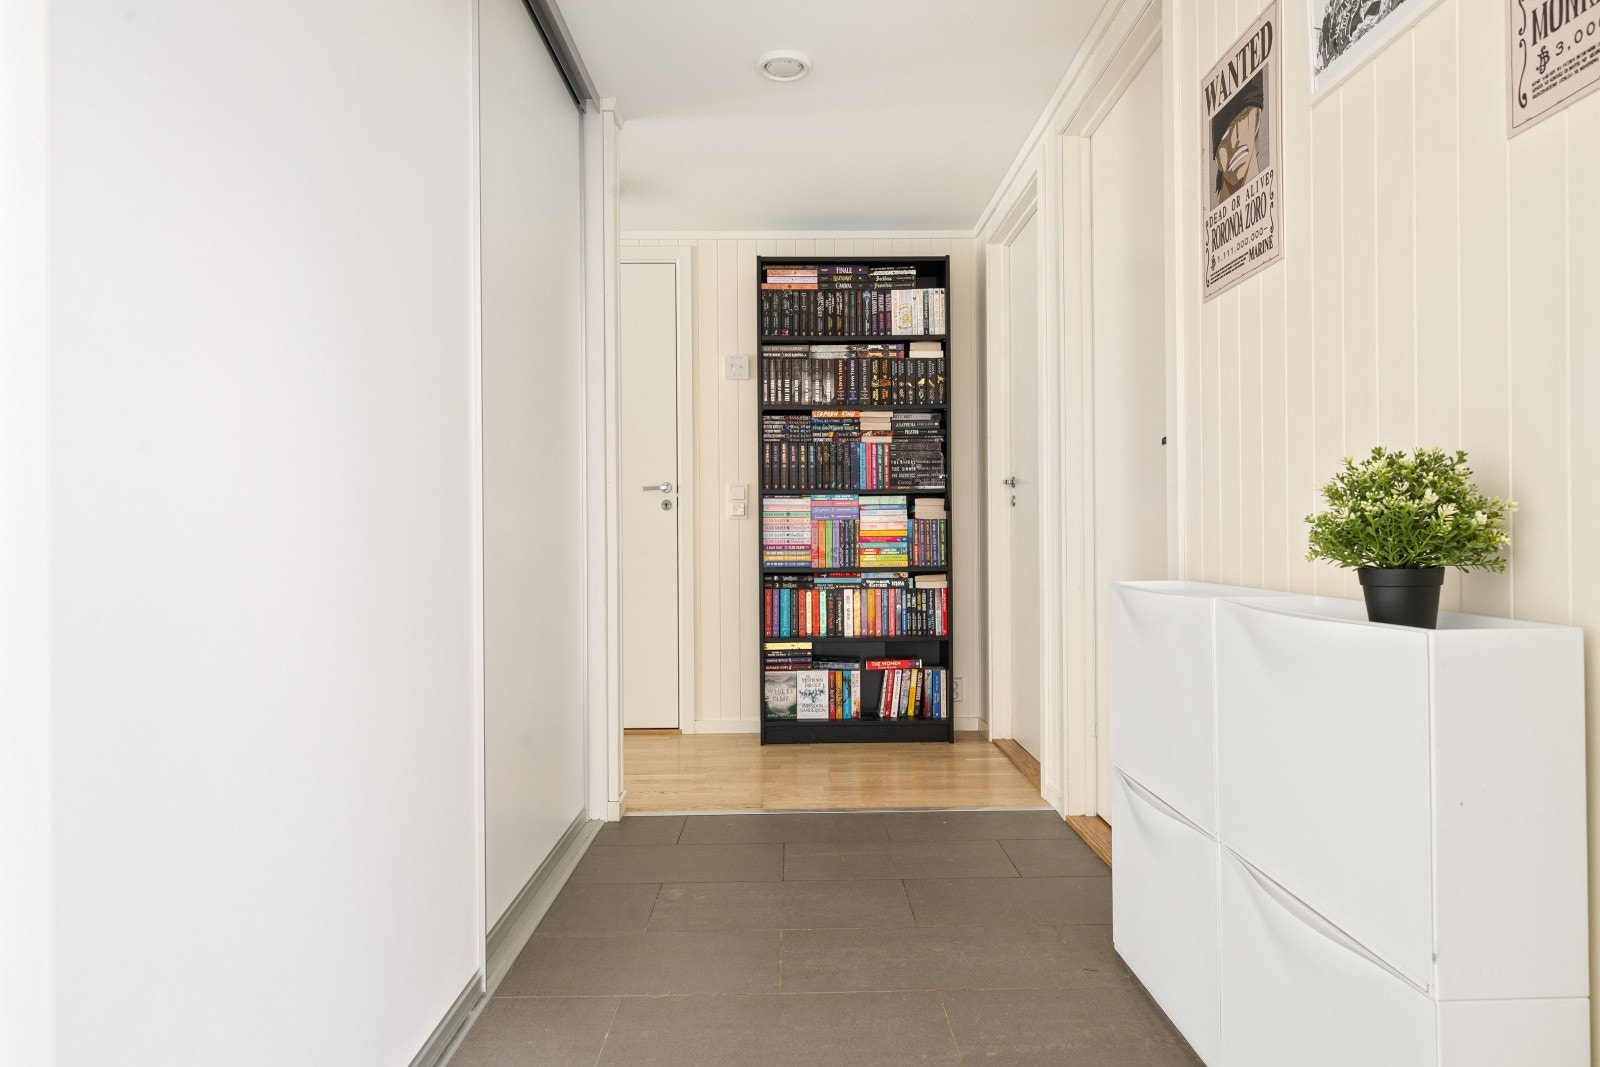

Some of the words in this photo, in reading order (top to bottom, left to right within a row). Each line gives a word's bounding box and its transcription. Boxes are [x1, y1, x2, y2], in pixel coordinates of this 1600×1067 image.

[1204, 21, 1272, 116] WANTED
[1209, 206, 1226, 227] DEAD
[1232, 195, 1240, 211] OR
[1246, 174, 1270, 201] ALIVE
[1211, 209, 1244, 252] RORONOA
[1246, 192, 1266, 229] ZORO
[1249, 235, 1274, 262] MARINE
